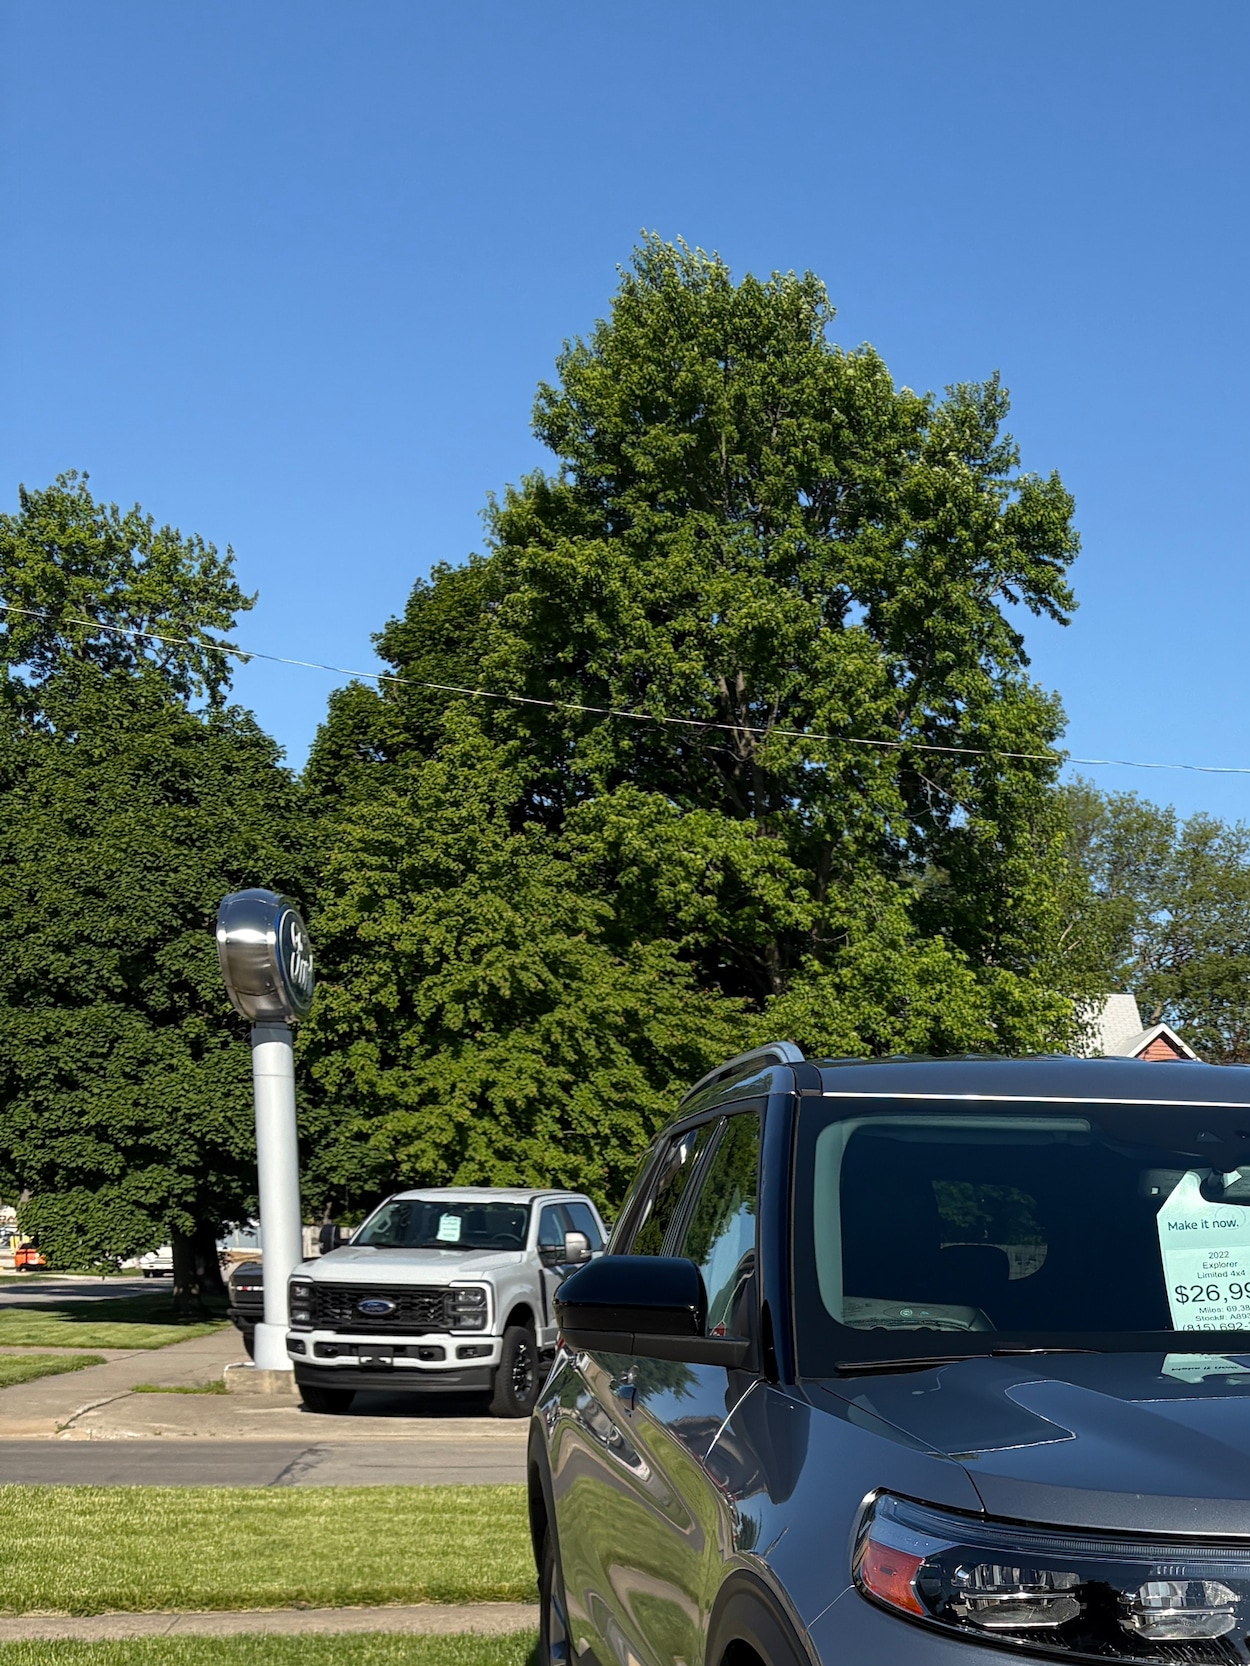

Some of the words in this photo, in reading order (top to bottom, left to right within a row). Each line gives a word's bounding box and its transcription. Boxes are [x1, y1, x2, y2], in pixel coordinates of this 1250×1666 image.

[1168, 1220, 1198, 1231] Make
[1201, 1219, 1209, 1229] it
[1212, 1219, 1239, 1228] now.
[1208, 1250, 1230, 1259] 2022
[1202, 1261, 1238, 1270] Explorer
[1197, 1270, 1228, 1279] Limited
[1230, 1269, 1246, 1277] 4x4
[1199, 1306, 1224, 1314] Miles:
[1195, 1314, 1227, 1322] Stock#:
